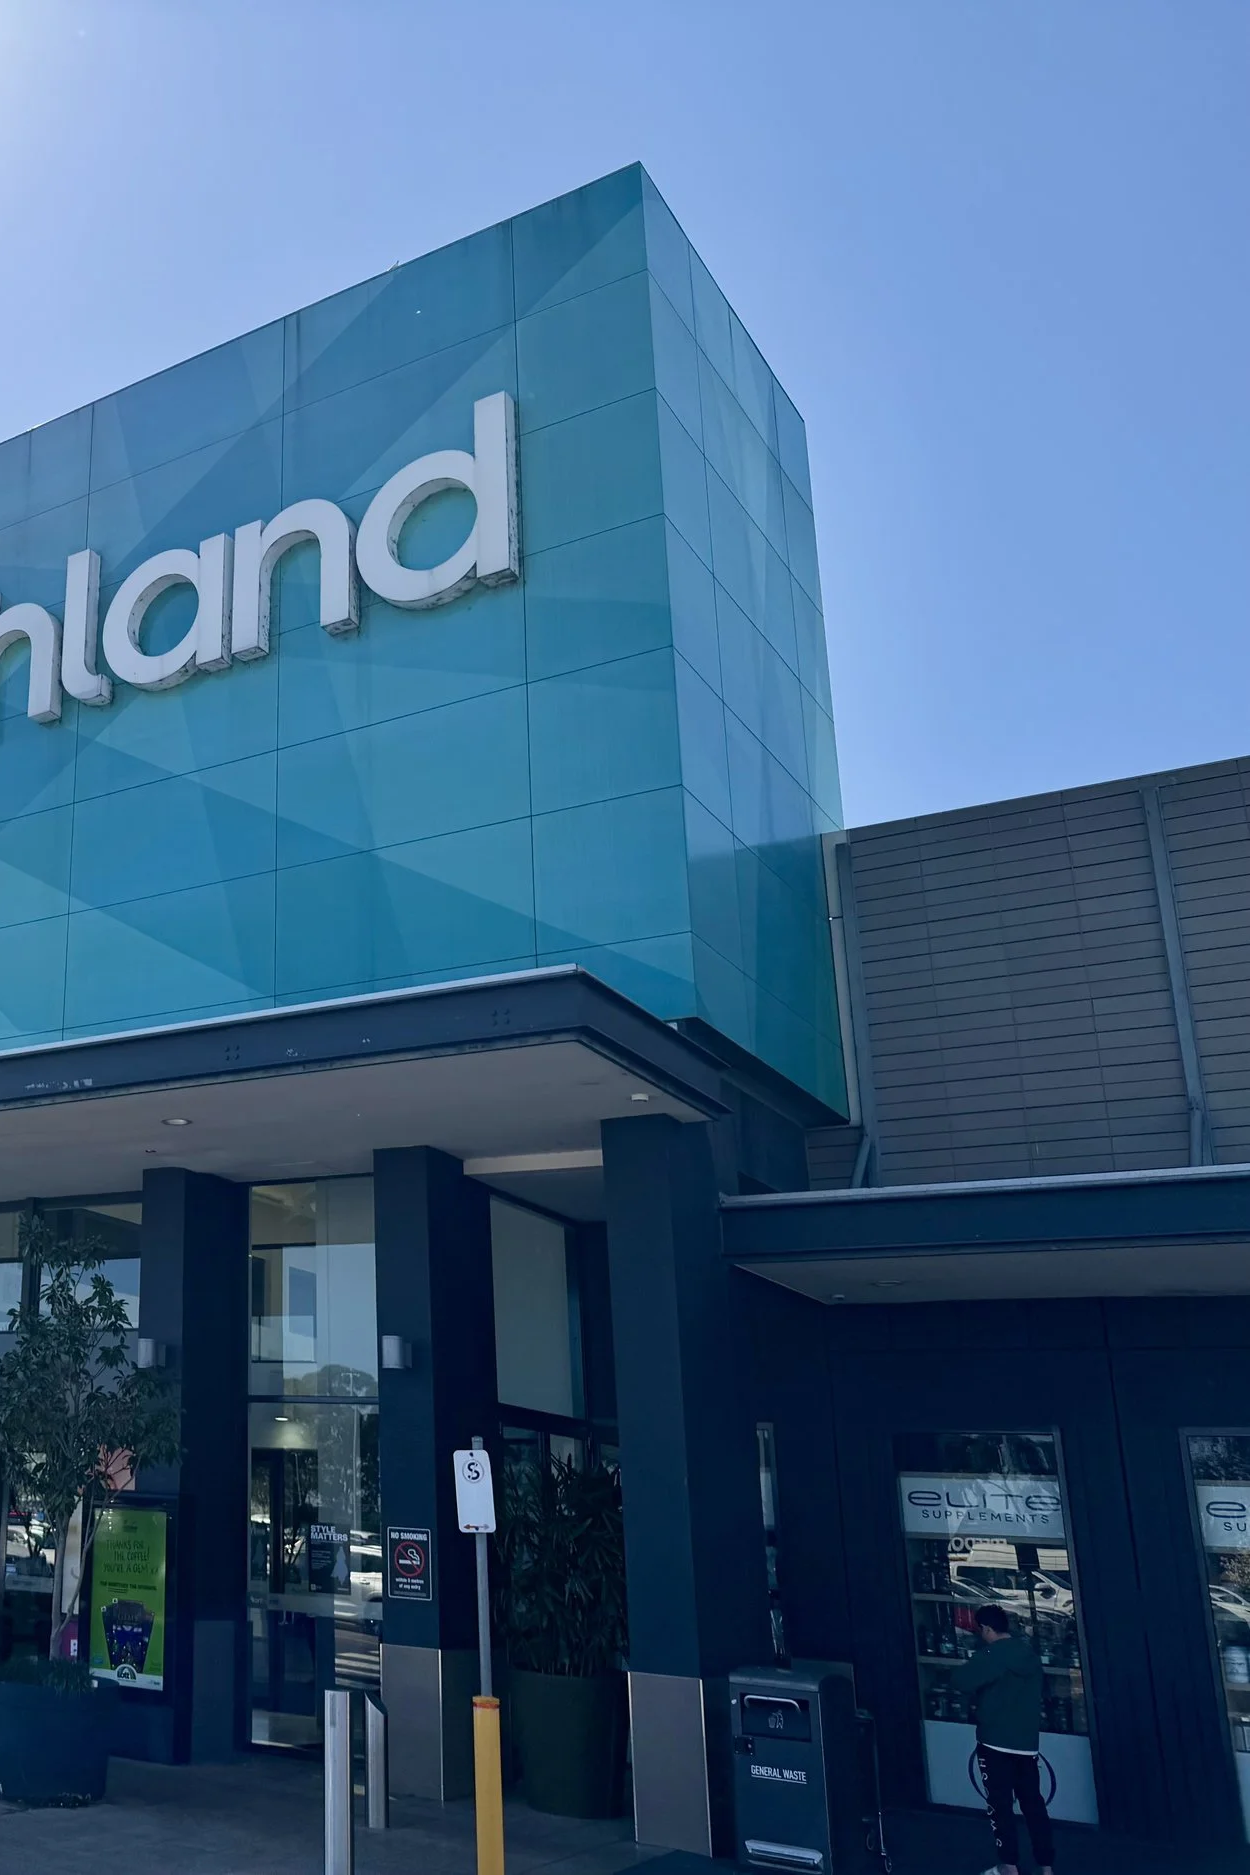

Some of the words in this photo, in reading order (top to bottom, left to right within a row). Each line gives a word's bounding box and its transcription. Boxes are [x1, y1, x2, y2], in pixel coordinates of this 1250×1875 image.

[921, 1509, 1050, 1524] SUPPLEMENTS
[310, 1524, 336, 1534] STYLE
[310, 1532, 348, 1542] MATTERS
[390, 1531, 399, 1539] NO
[400, 1532, 428, 1541] SMOKING
[750, 1764, 782, 1778] GENERAL
[782, 1768, 807, 1782] WASTE
